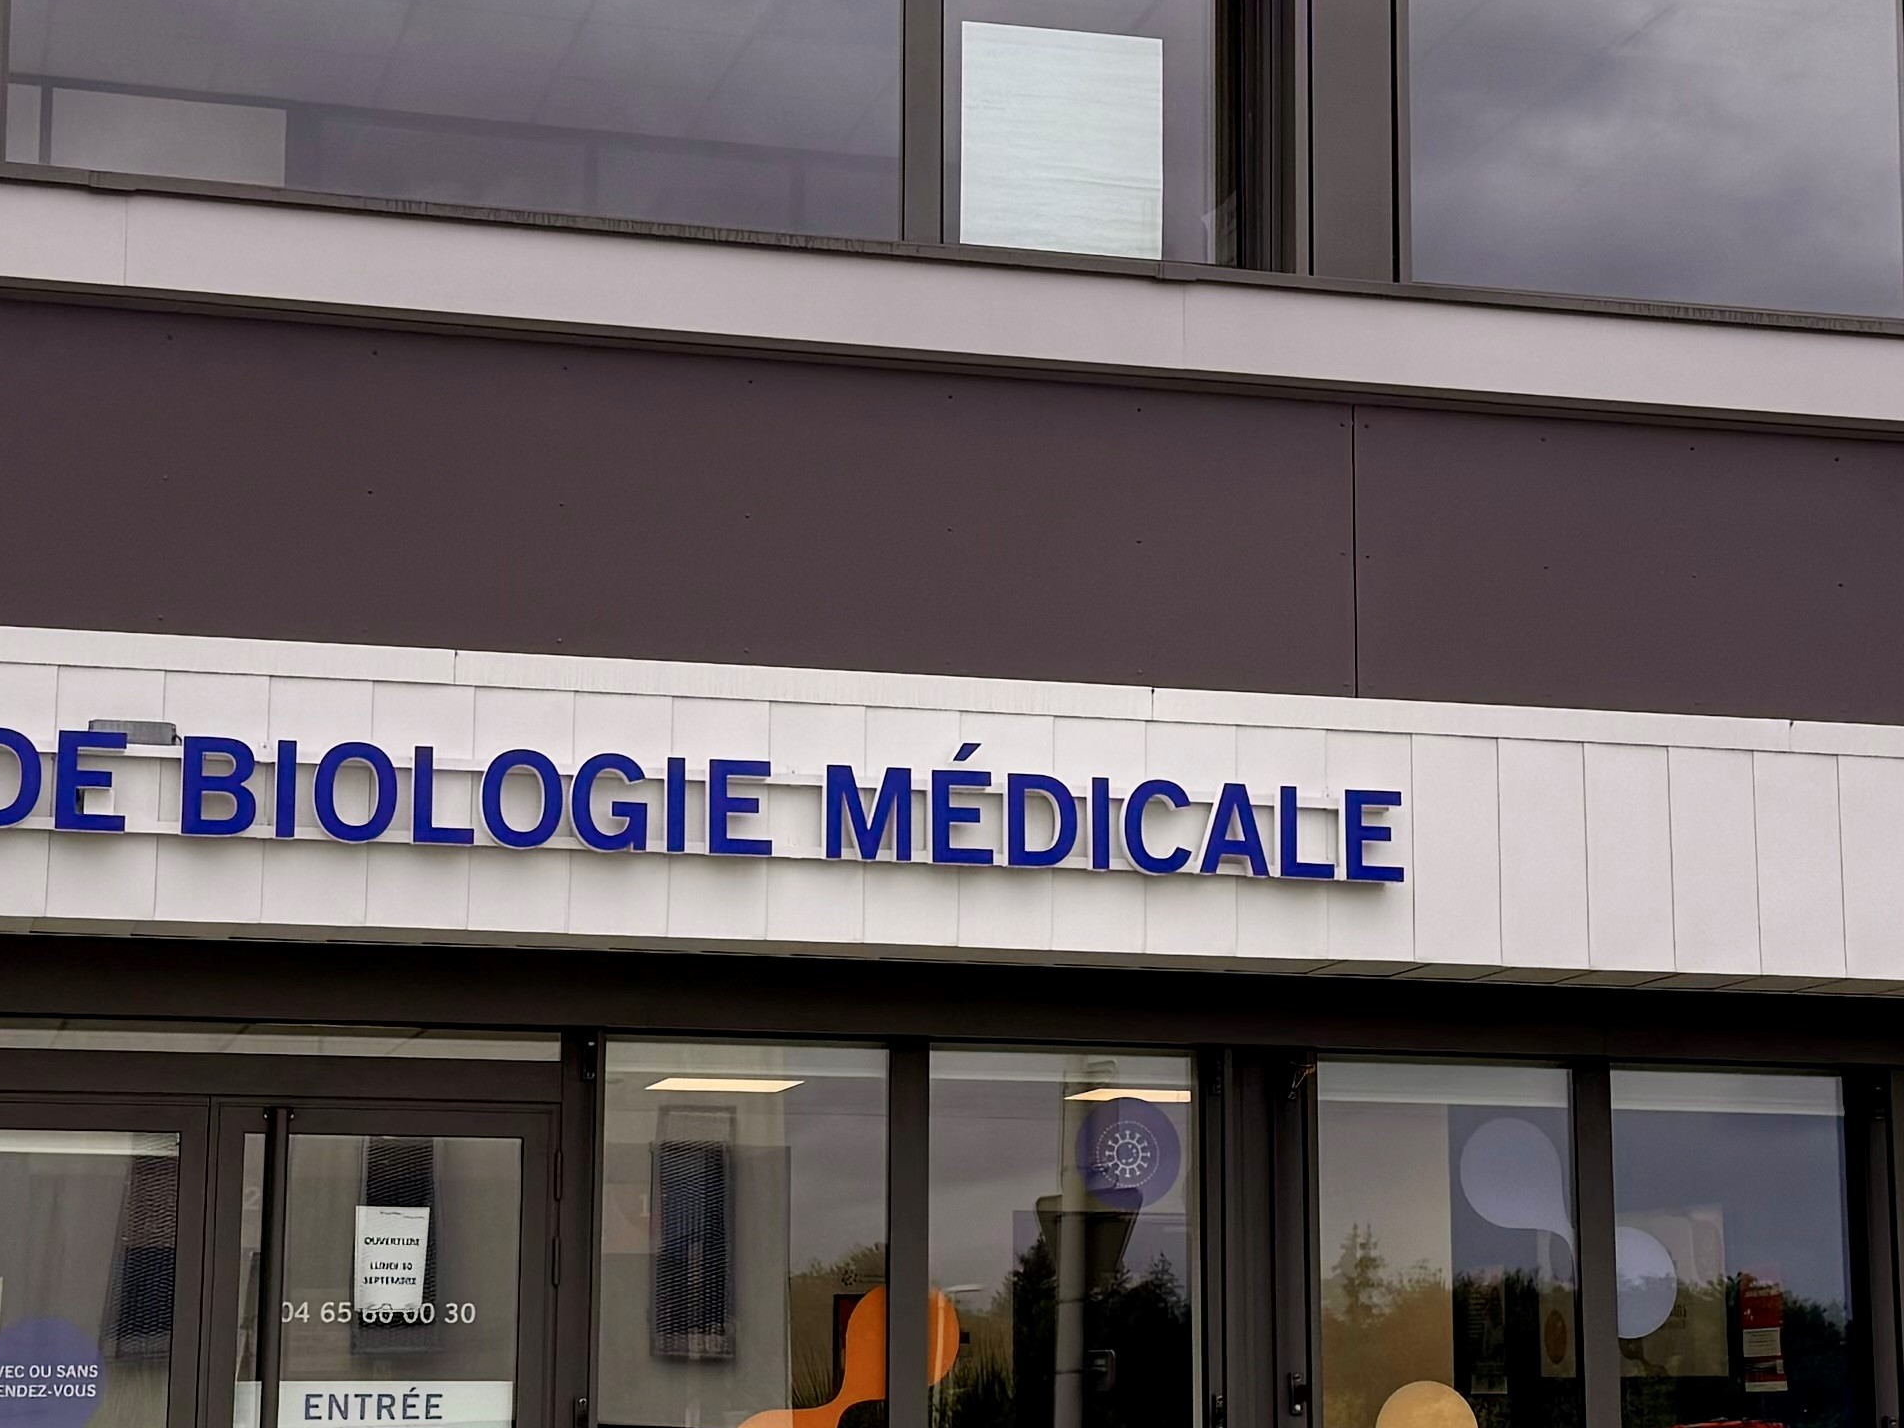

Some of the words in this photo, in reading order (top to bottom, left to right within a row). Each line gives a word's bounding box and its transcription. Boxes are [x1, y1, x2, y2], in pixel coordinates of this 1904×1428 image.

[180, 734, 773, 858] BIOLOGIE
[825, 742, 1406, 885] MÉDICALE
[281, 1301, 310, 1324] 04
[321, 1302, 352, 1324] 65
[444, 1302, 476, 1324] 30
[29, 1365, 52, 1378] OU
[56, 1364, 99, 1378] SANS
[304, 1387, 444, 1421] ENTRÉE
